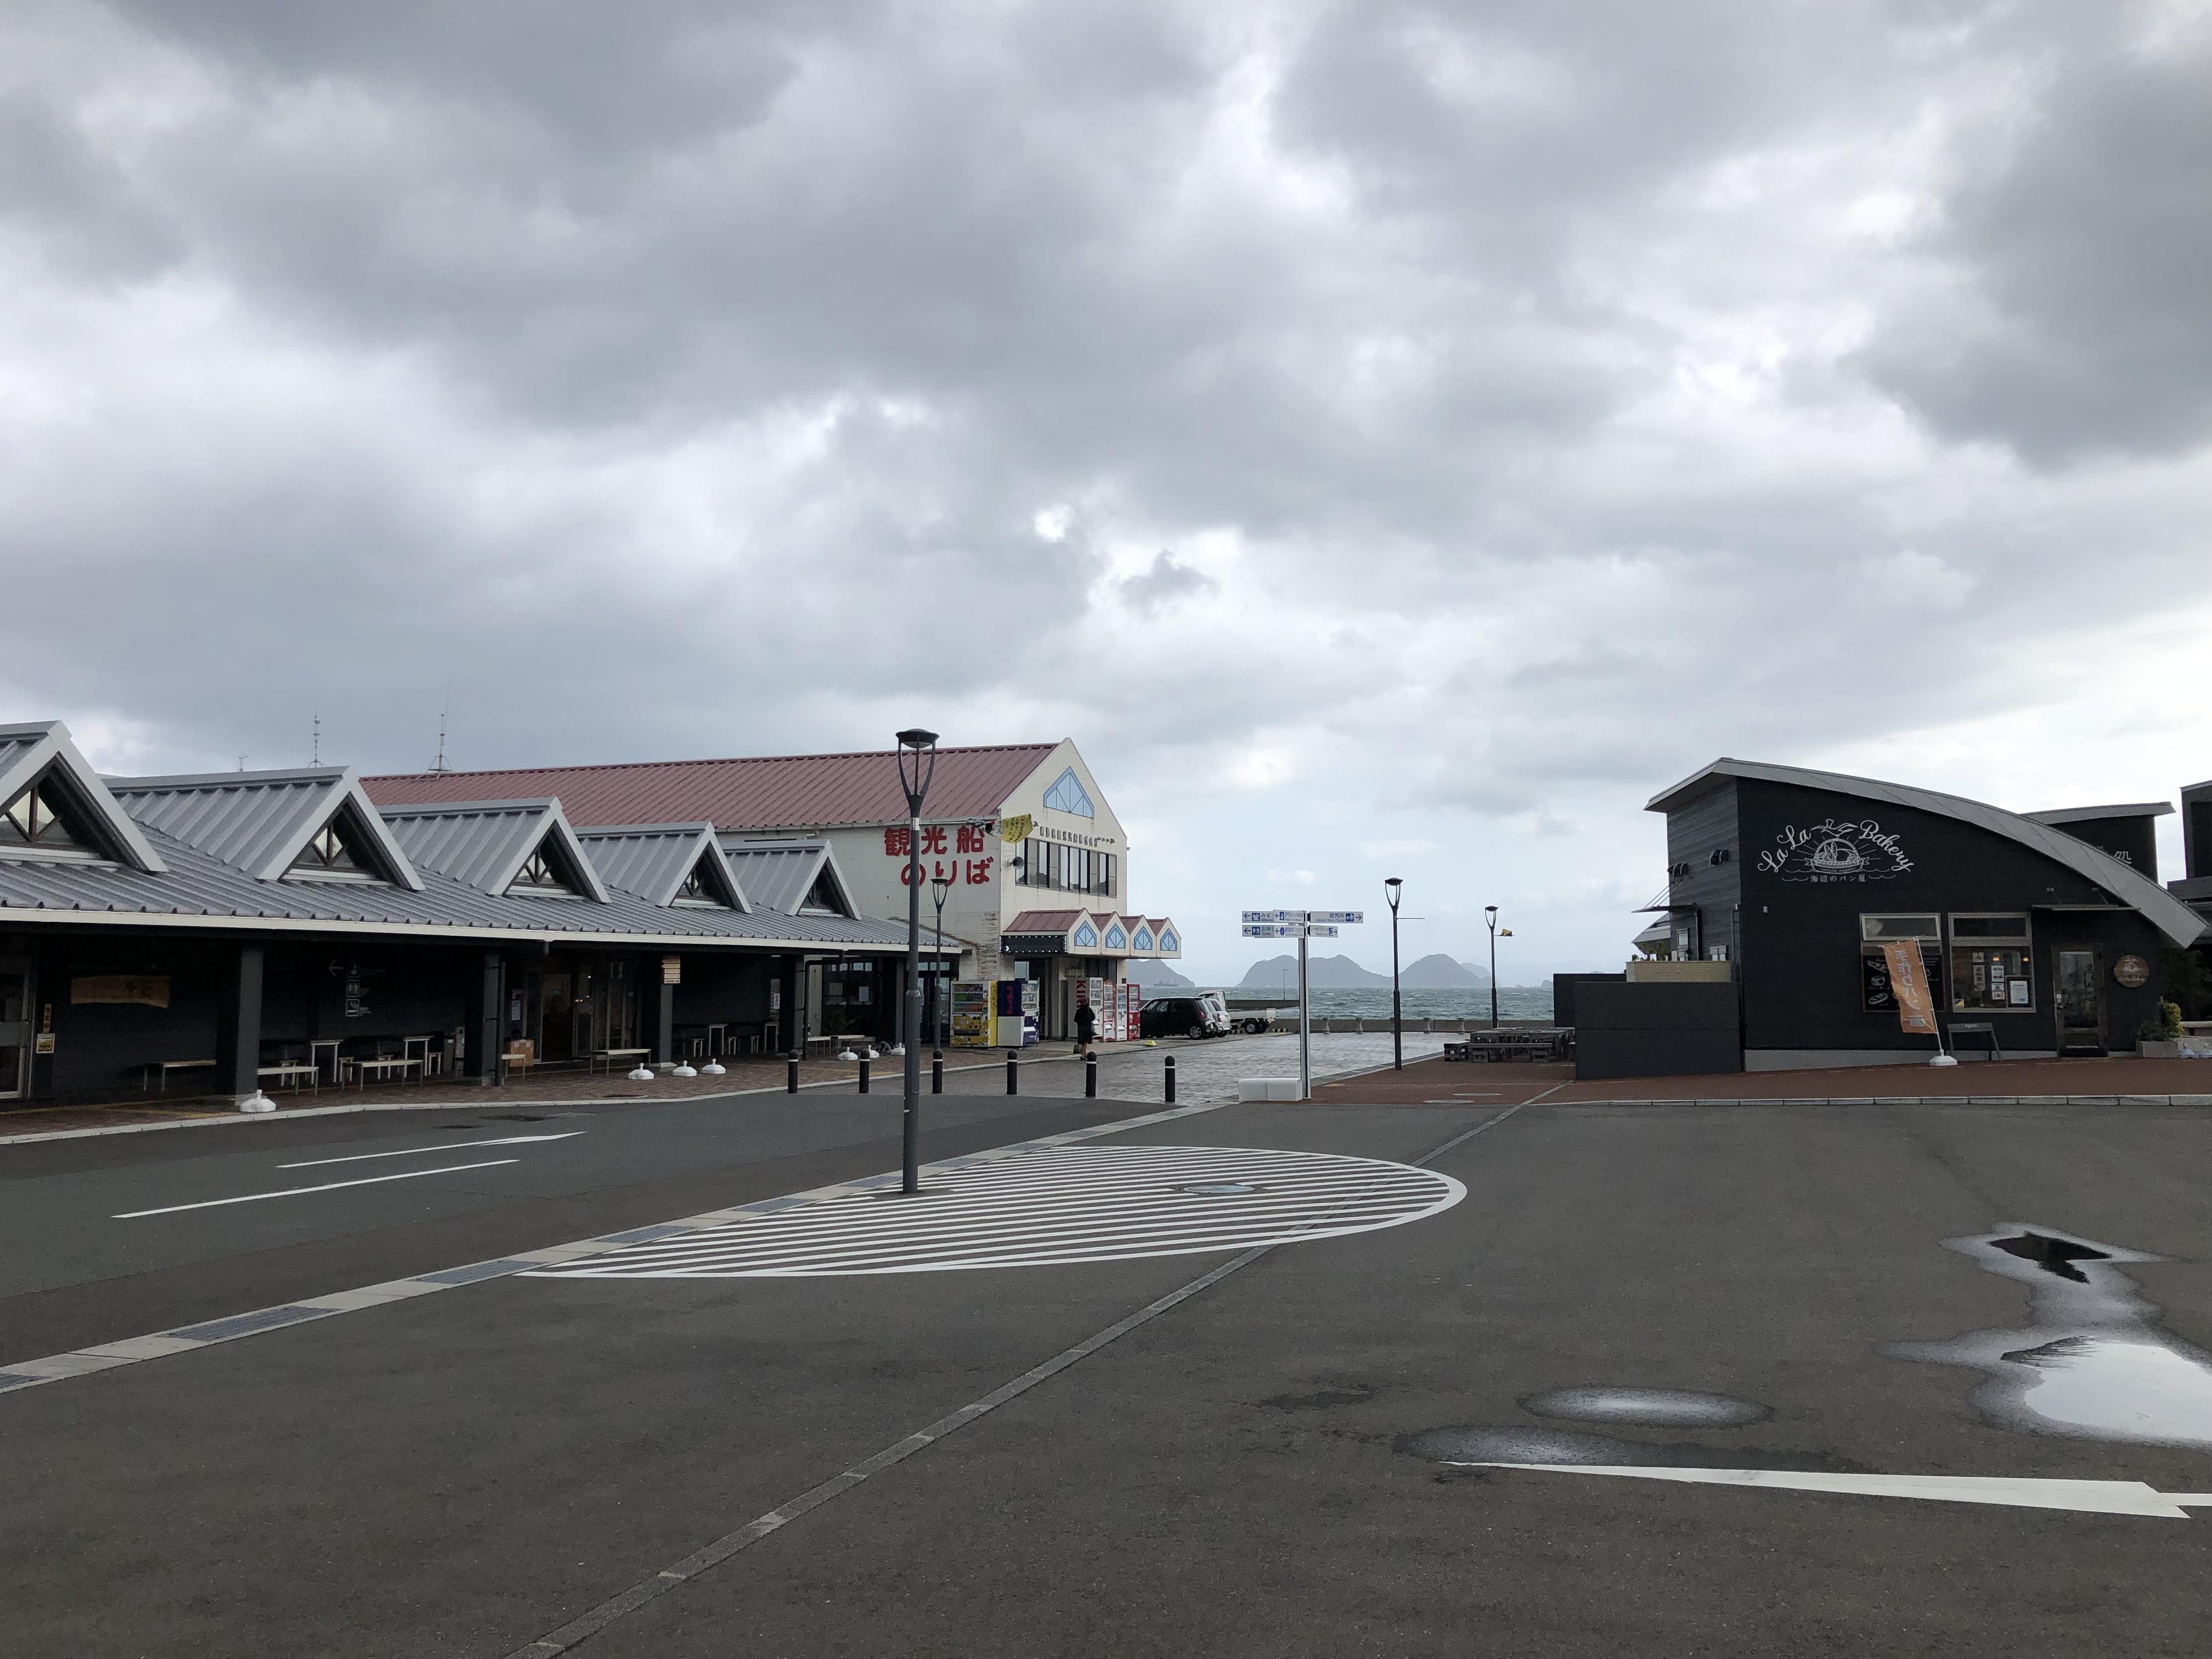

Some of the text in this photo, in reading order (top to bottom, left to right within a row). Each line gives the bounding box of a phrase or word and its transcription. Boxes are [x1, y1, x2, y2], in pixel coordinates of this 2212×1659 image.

[884, 825, 985, 857] 観光船
[1757, 819, 1915, 873] La La Bakery
[900, 856, 995, 887] のりば
[1810, 874, 1866, 883] 海辺のパン屋
